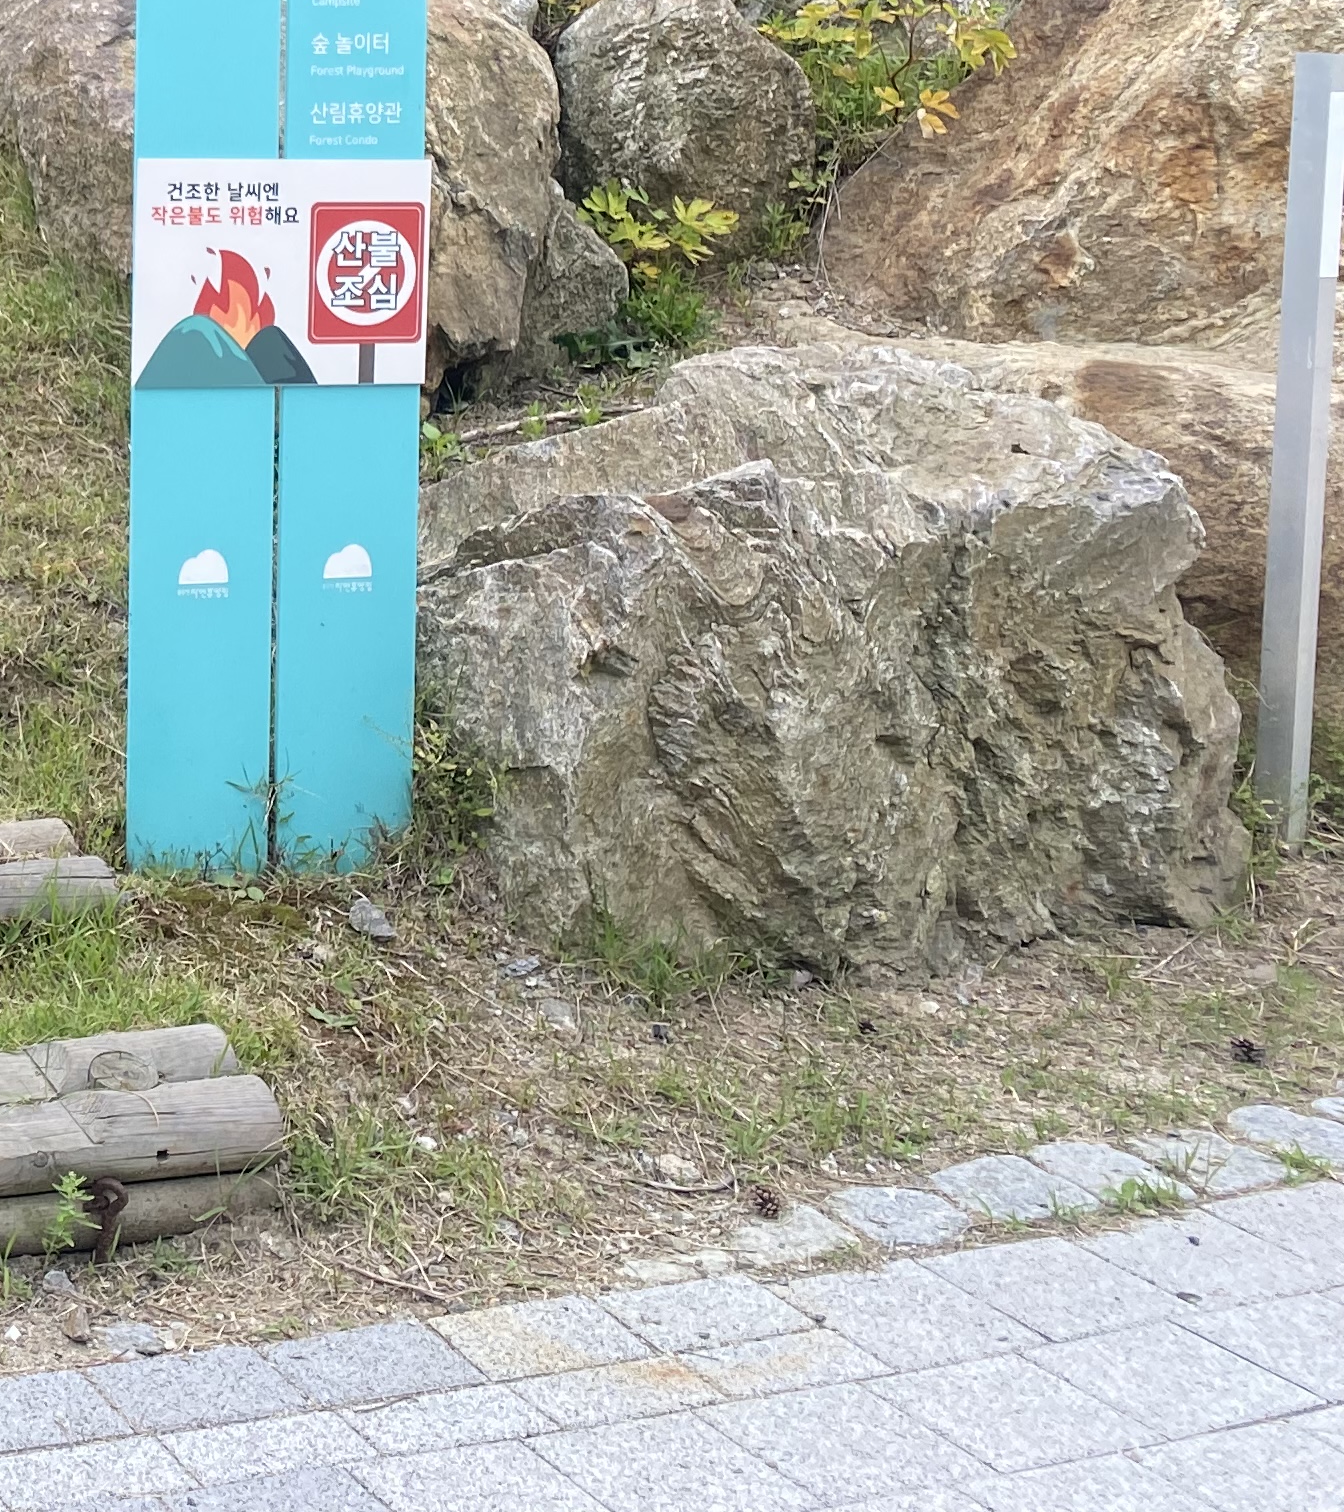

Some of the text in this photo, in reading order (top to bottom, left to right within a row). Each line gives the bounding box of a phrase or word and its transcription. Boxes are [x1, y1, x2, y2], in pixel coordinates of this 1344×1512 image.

[311, 31, 389, 55] 숲 놀이터
[311, 65, 404, 78] Forest Playground
[310, 101, 402, 125] 산림휴양관
[309, 135, 378, 146] Forest Condo
[167, 182, 280, 202] 건조한 날씨엔
[151, 205, 299, 226] 작은불도 위험해요
[333, 230, 400, 267] 산불
[331, 273, 398, 310] 조심
